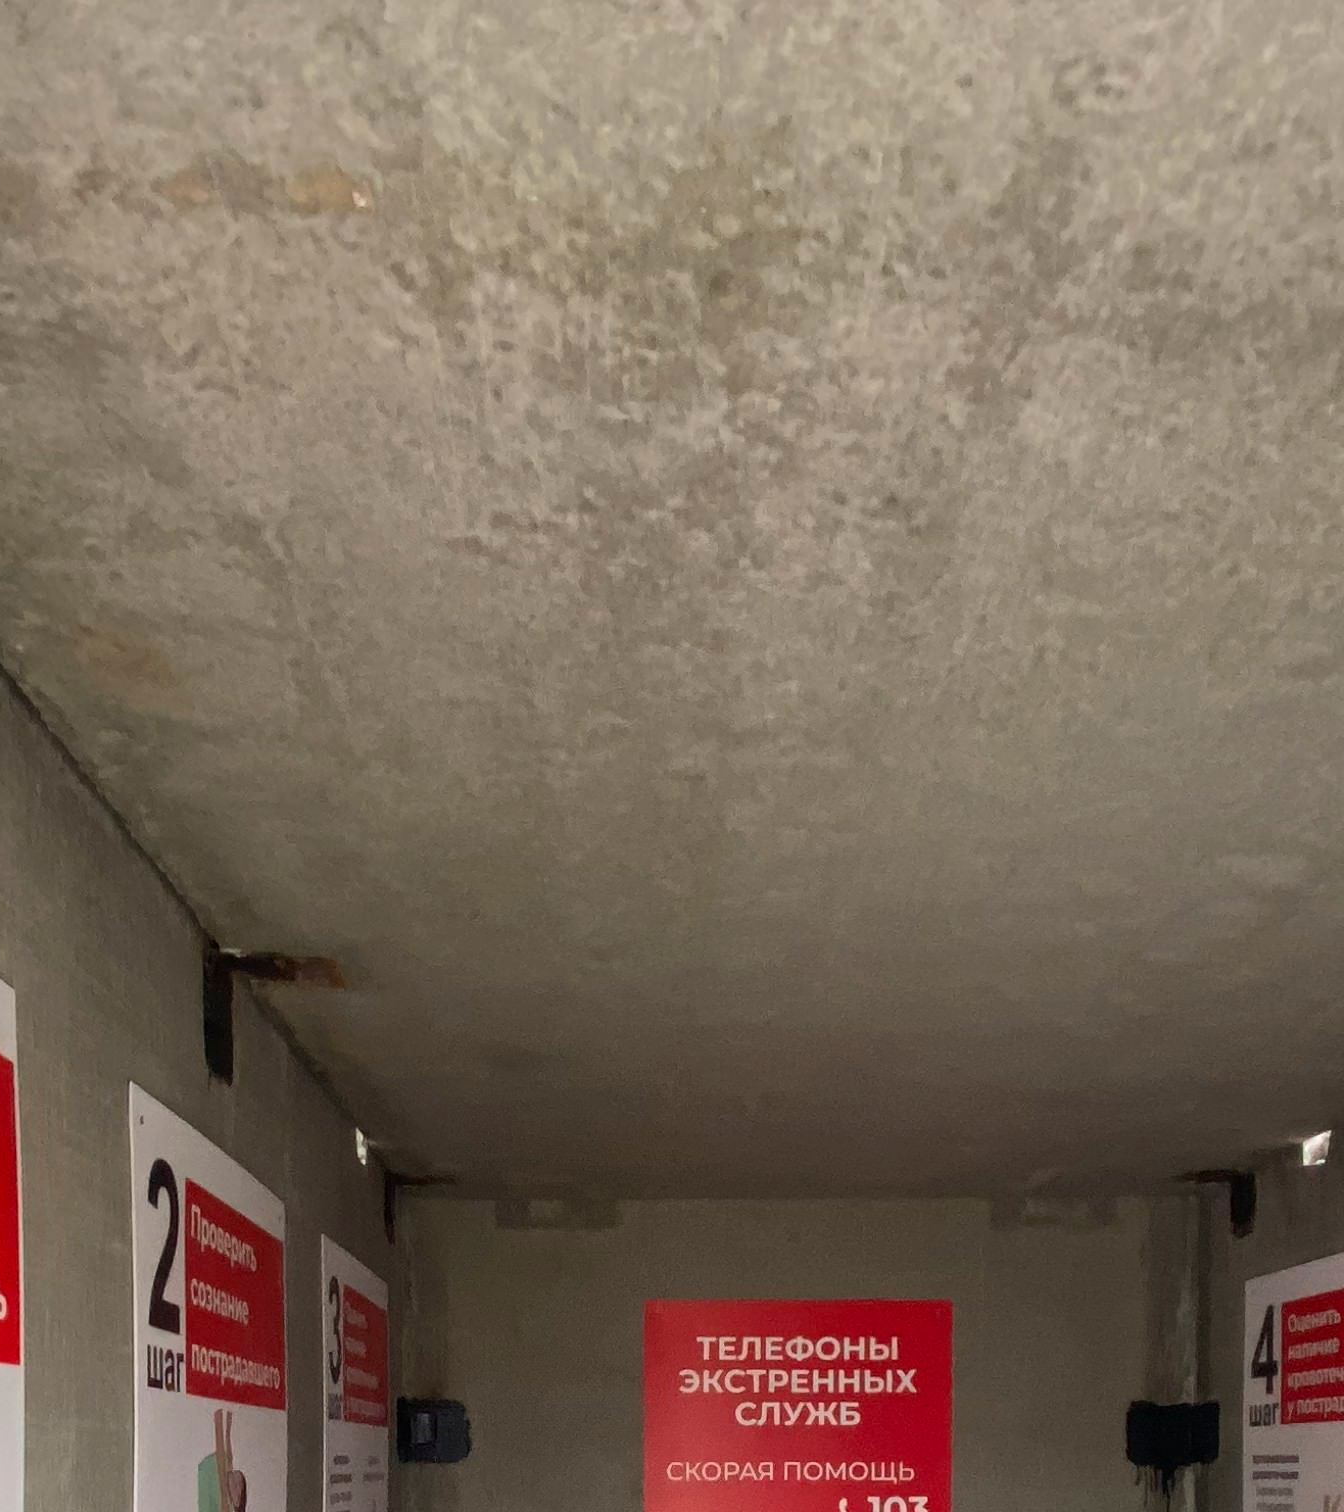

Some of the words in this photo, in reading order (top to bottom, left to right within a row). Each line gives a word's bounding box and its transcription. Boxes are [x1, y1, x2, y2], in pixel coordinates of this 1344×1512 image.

[147, 1158, 180, 1335] 2
[190, 1203, 258, 1272] Проверить
[190, 1279, 249, 1326] сознание
[329, 1276, 342, 1384] 3
[696, 1335, 899, 1361] ТЕЛЕФОНЫ
[1250, 1303, 1278, 1395] 4
[146, 1343, 184, 1394] шаг
[191, 1343, 281, 1392] пострадавшего
[678, 1369, 917, 1393] ЭКСТРЕННЫХ
[734, 1401, 861, 1426] СЛУЖБ
[1249, 1402, 1279, 1427] шаг
[666, 1461, 774, 1481] СКОРАЯ
[783, 1461, 915, 1484] ПОМОЩЬ
